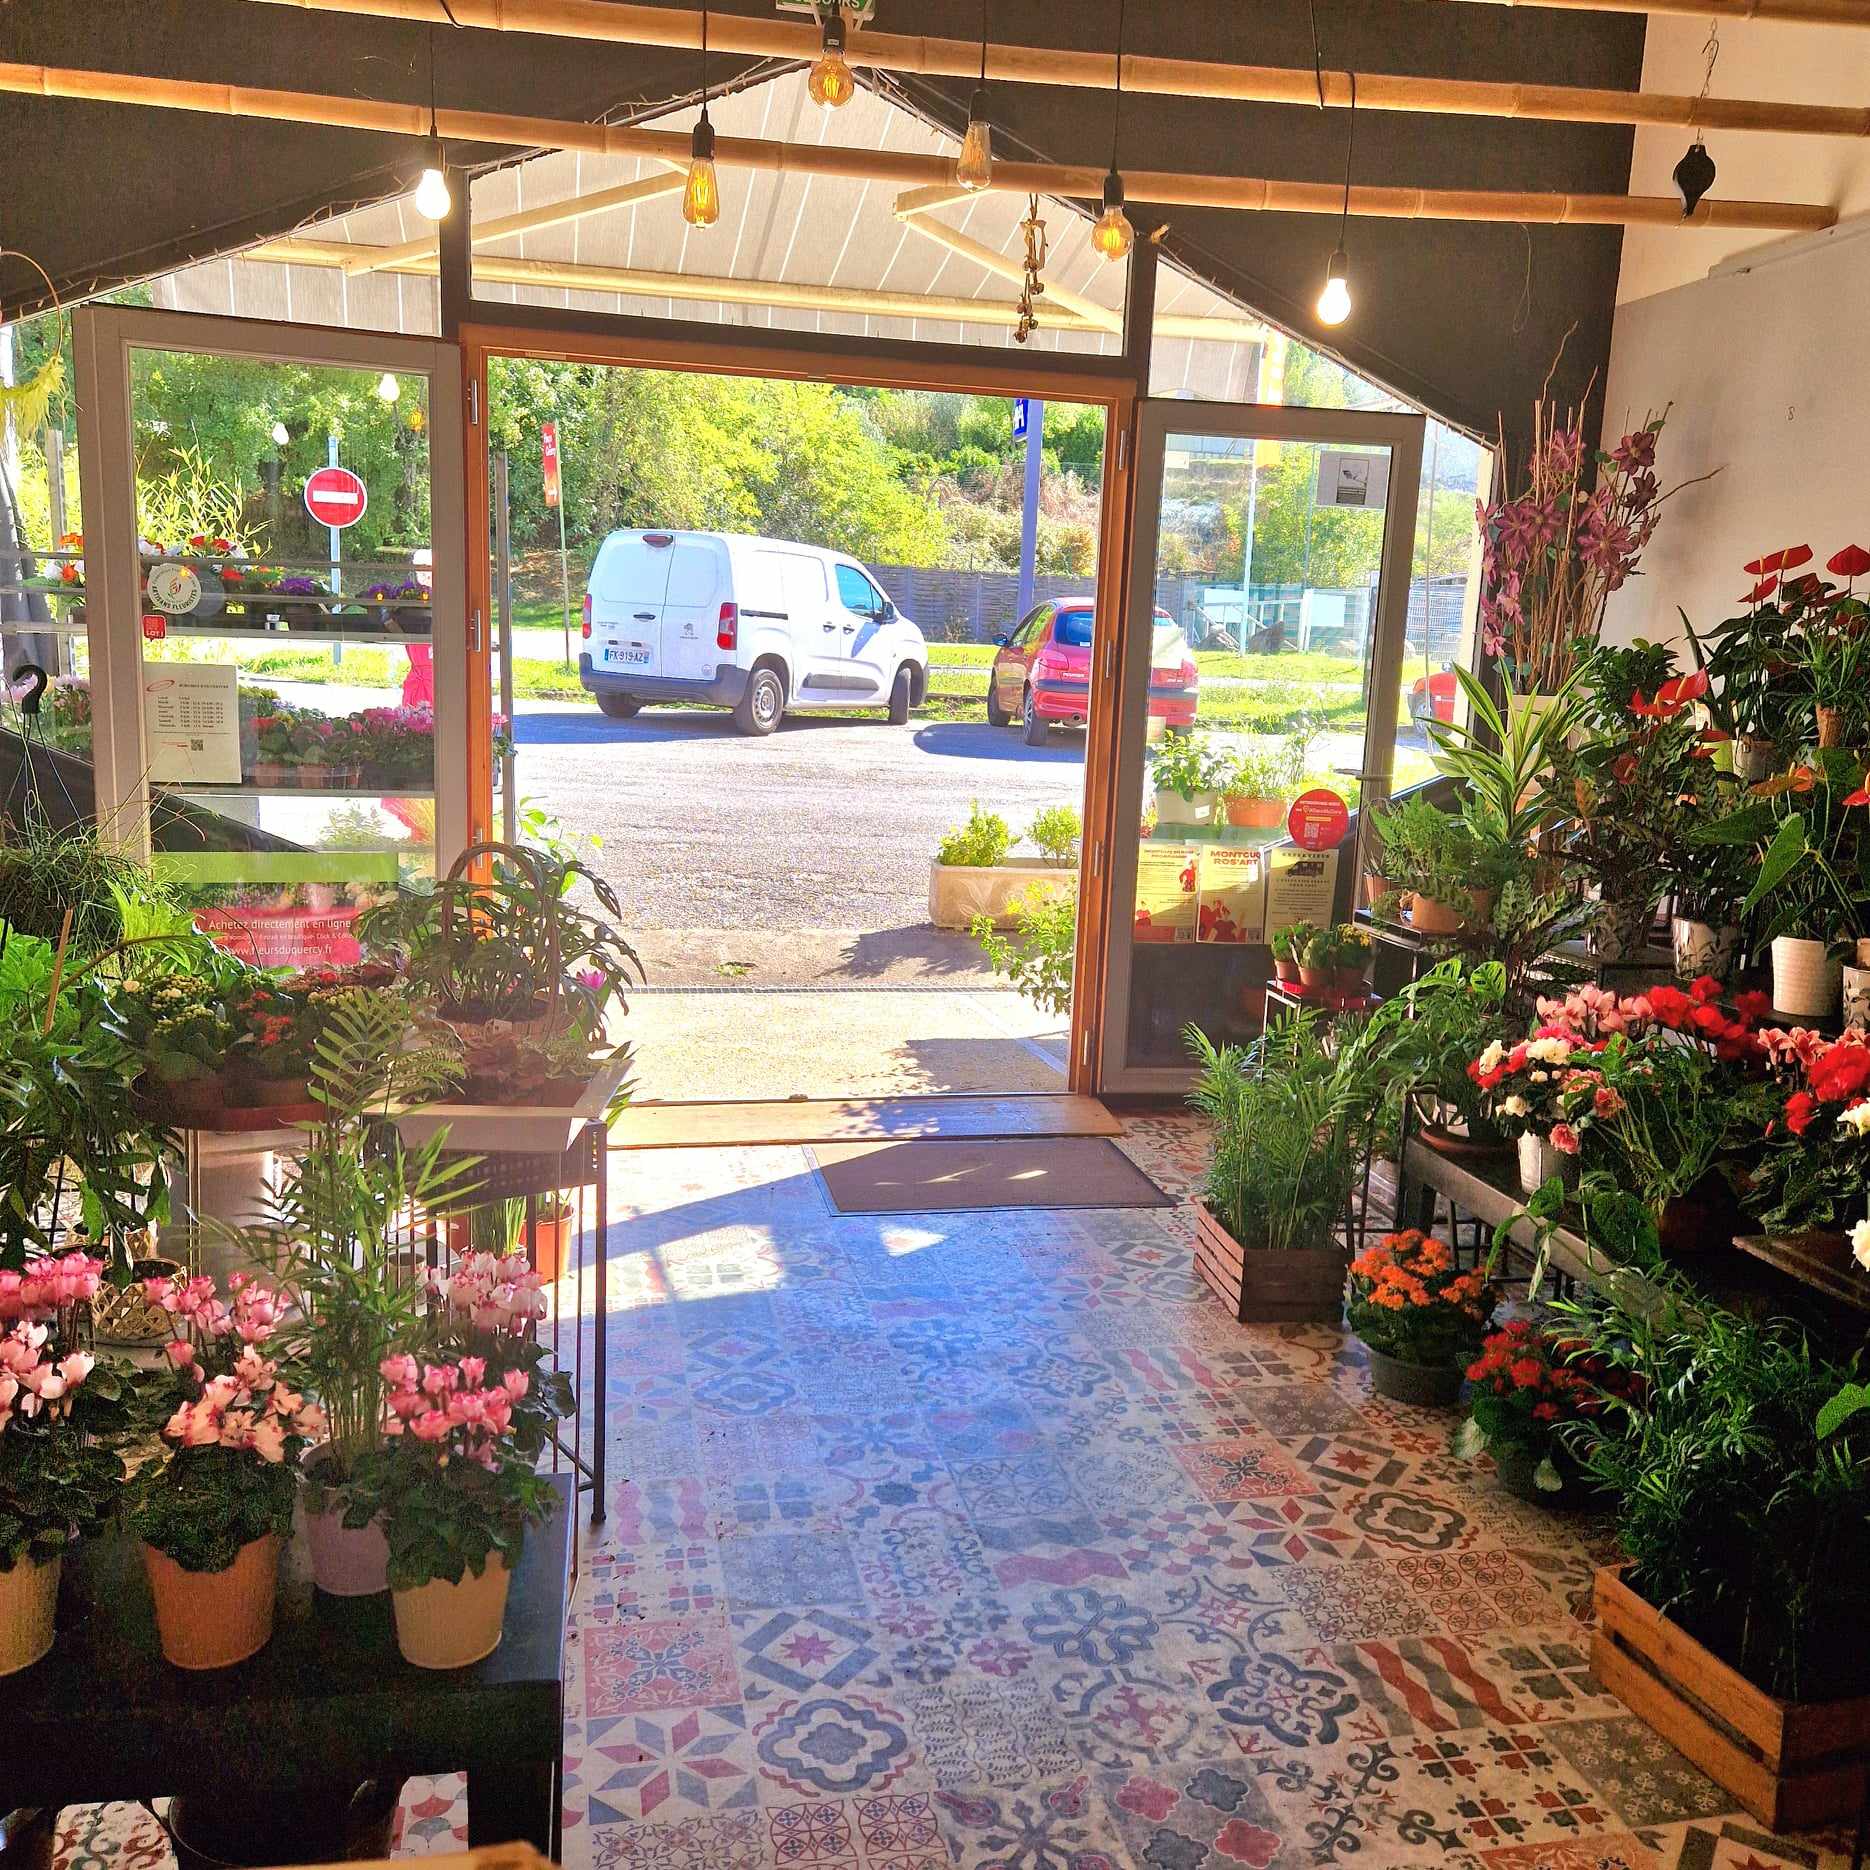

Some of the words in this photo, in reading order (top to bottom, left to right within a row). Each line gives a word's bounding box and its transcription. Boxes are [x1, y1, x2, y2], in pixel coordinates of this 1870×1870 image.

[208, 919, 248, 930] Achetez
[251, 918, 310, 930] directement
[313, 920, 325, 929] en
[328, 918, 351, 931] ligne
[229, 944, 332, 956] ww.feursduquercy.fr
